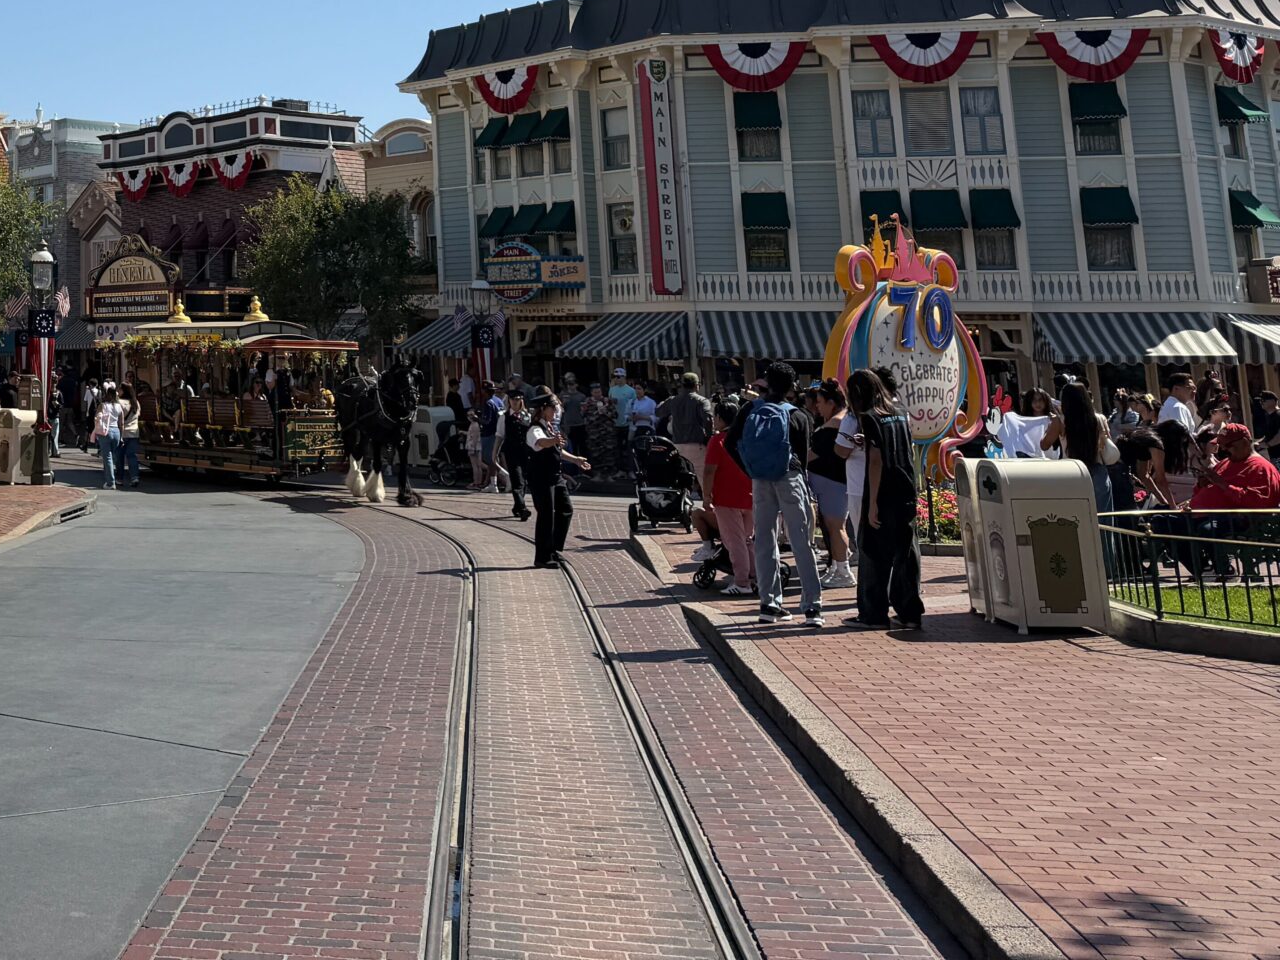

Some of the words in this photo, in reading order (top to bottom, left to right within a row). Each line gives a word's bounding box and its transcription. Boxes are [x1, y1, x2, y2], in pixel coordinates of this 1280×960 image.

[654, 91, 667, 147] MAIN
[660, 163, 674, 251] STREET
[548, 265, 579, 279] JOKES
[504, 289, 523, 297] STREET
[887, 280, 955, 352] 70
[890, 361, 953, 389] CELEBRATE
[905, 383, 945, 407] HAPPY
